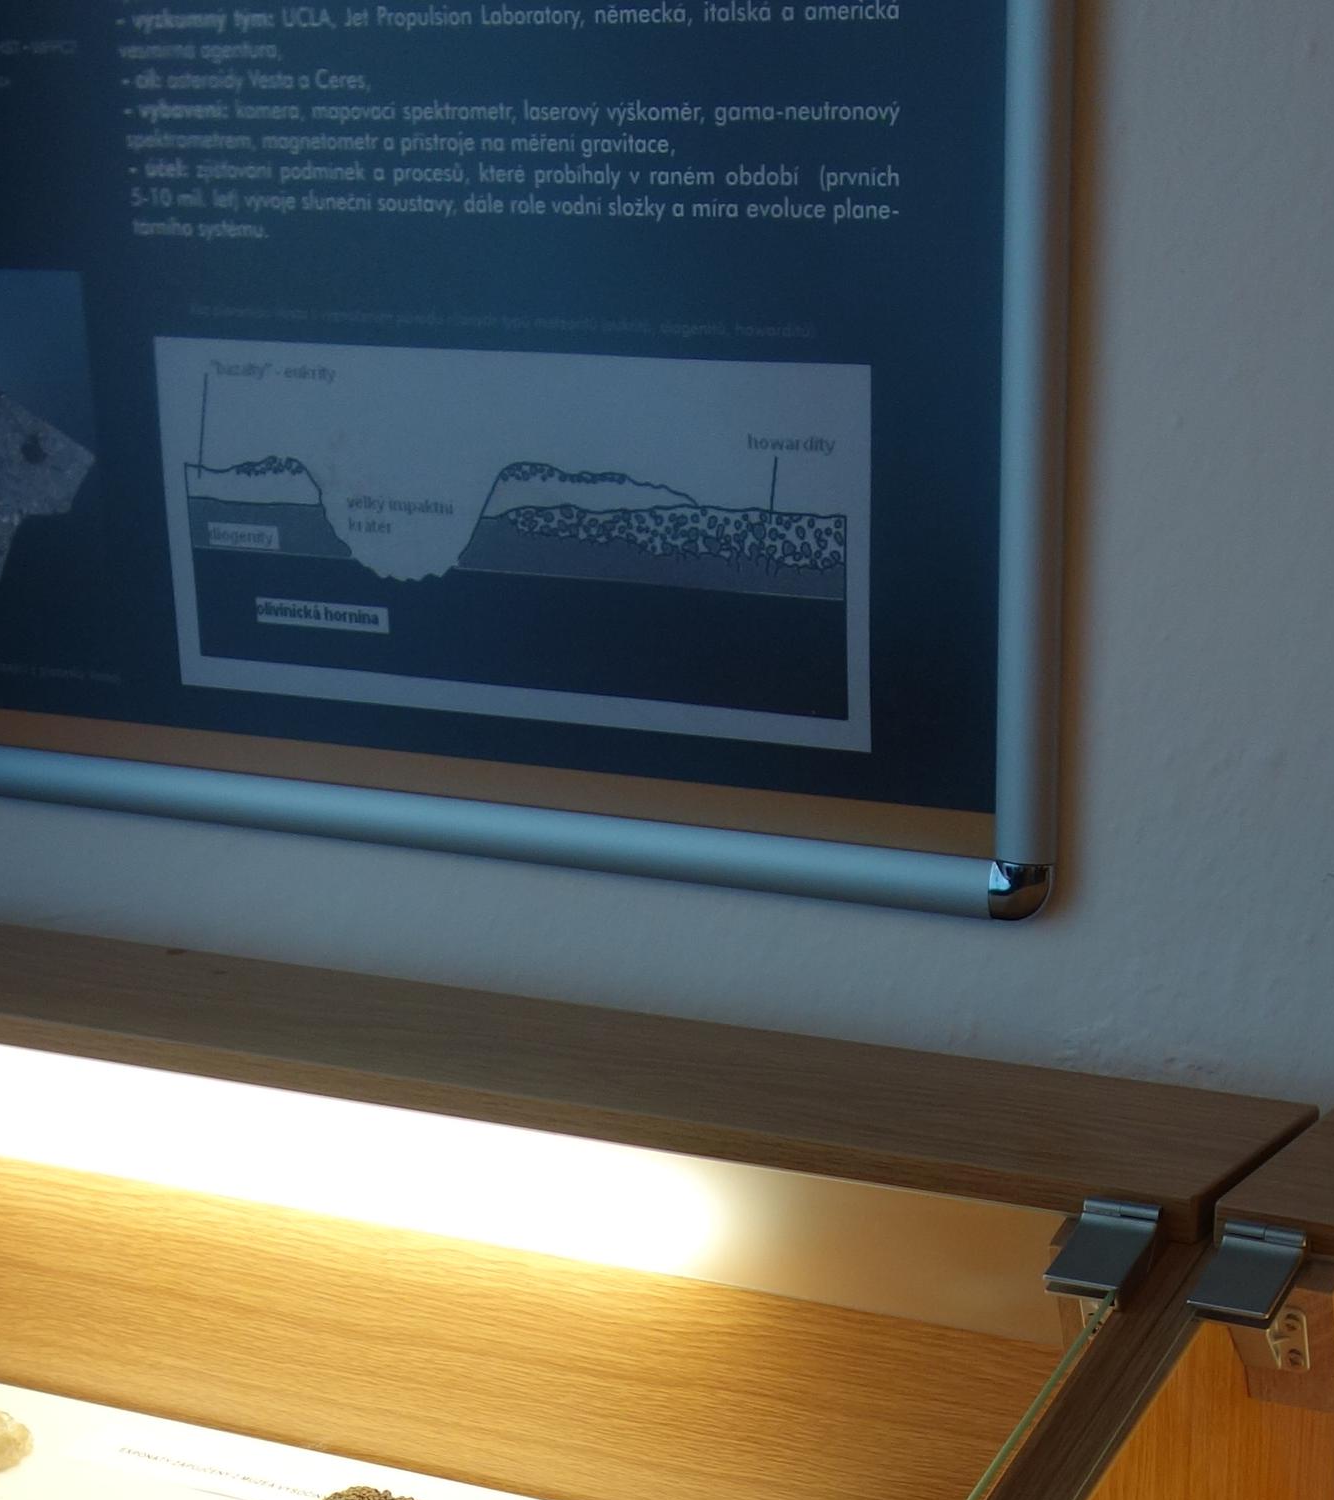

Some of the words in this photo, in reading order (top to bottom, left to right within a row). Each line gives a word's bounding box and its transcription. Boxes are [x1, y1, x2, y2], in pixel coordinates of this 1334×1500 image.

[344, 6, 368, 27] Jet
[376, 6, 472, 31] Propulsion
[481, 4, 585, 30] Laboratory,
[594, 1, 694, 27] německá,
[781, 7, 794, 23] a
[301, 188, 372, 213] sluneční
[377, 192, 457, 217] soustavy,
[463, 189, 504, 213] dále
[510, 193, 546, 215] role
[551, 193, 603, 216] vodní
[607, 194, 666, 222] složky
[672, 203, 685, 217] a
[691, 198, 739, 218] míra
[746, 196, 826, 219] evoluce
[833, 194, 900, 223] plane-
[747, 432, 836, 456] howardity
[256, 601, 322, 620] olivinická
[324, 606, 380, 626] hornina
